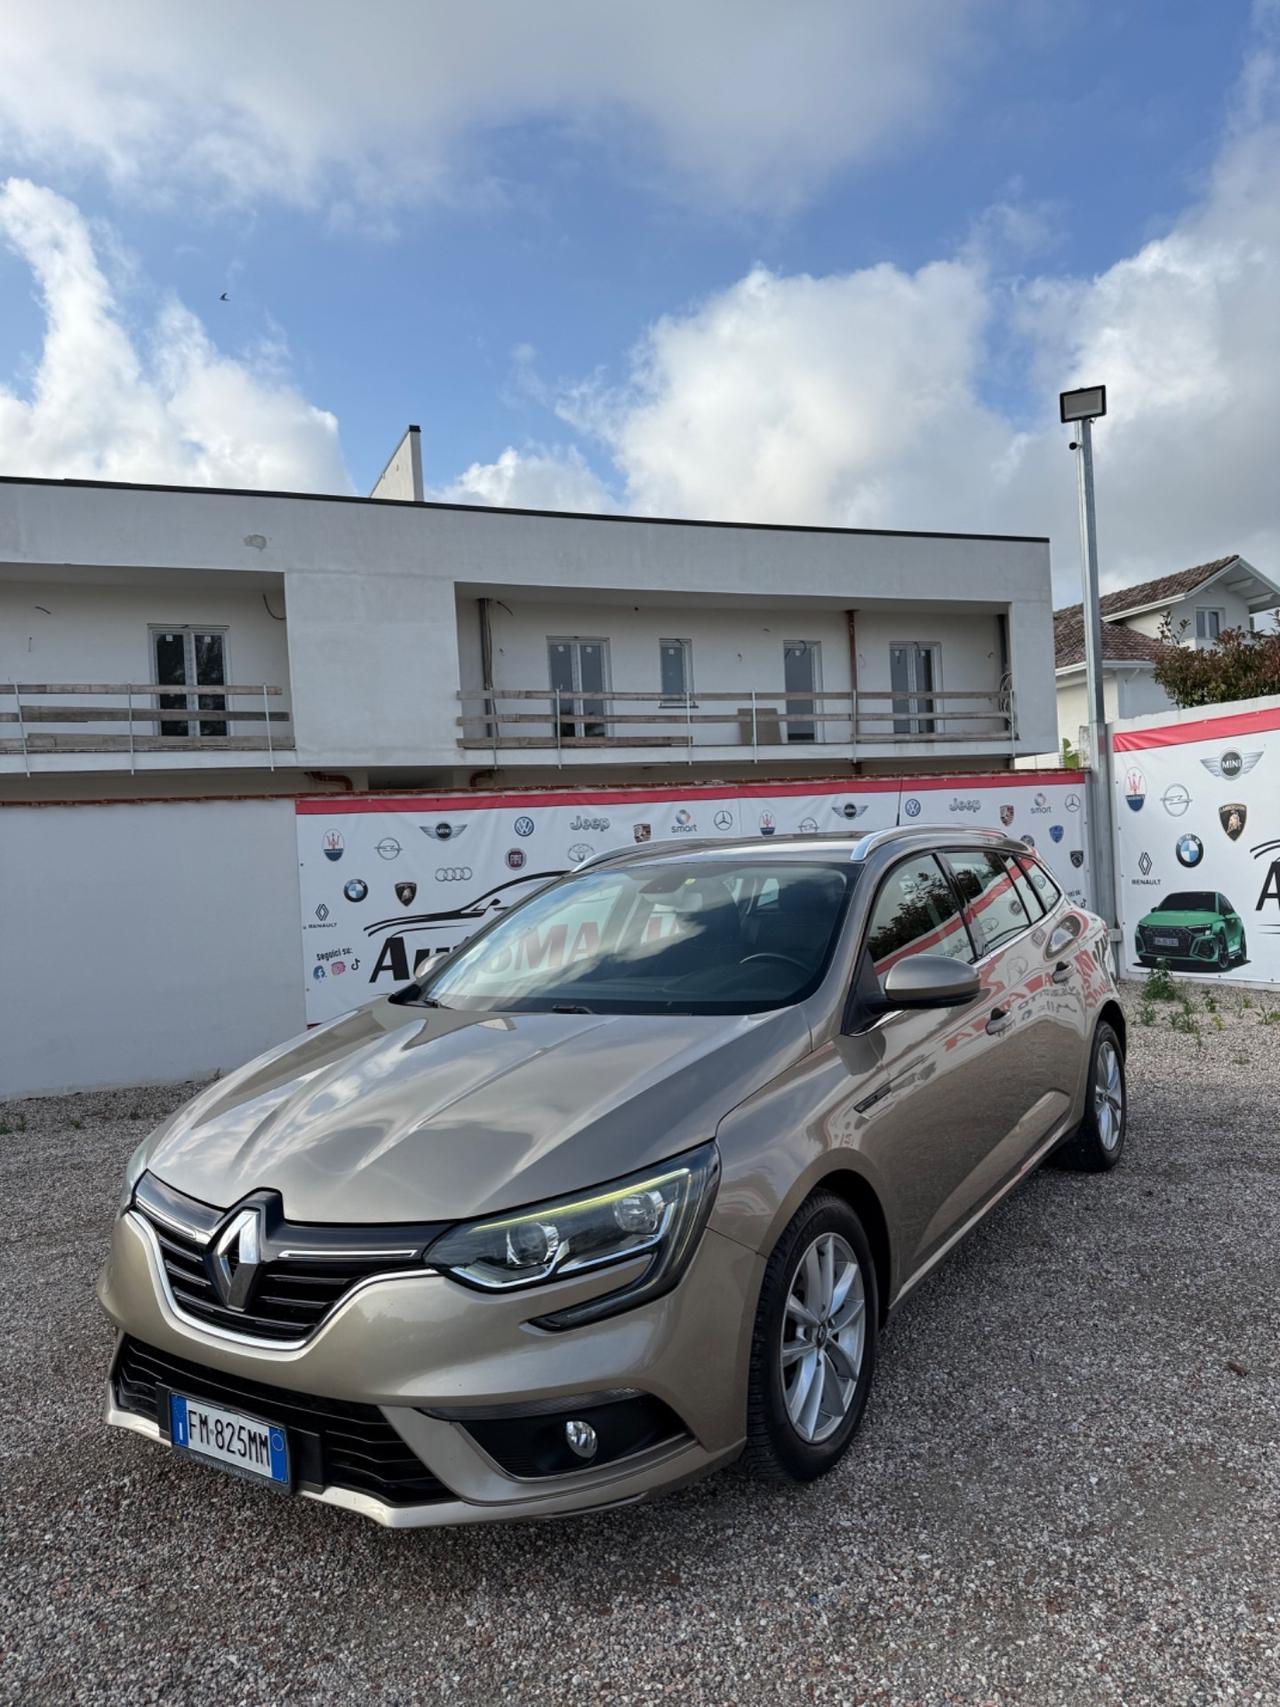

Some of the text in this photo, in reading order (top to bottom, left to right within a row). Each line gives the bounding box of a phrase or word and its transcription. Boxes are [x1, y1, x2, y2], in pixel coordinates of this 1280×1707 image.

[1222, 759, 1242, 769] MINI
[949, 798, 981, 812] Jeep
[1030, 806, 1052, 814] smart
[570, 816, 610, 831] Jeep
[671, 824, 697, 833] smart
